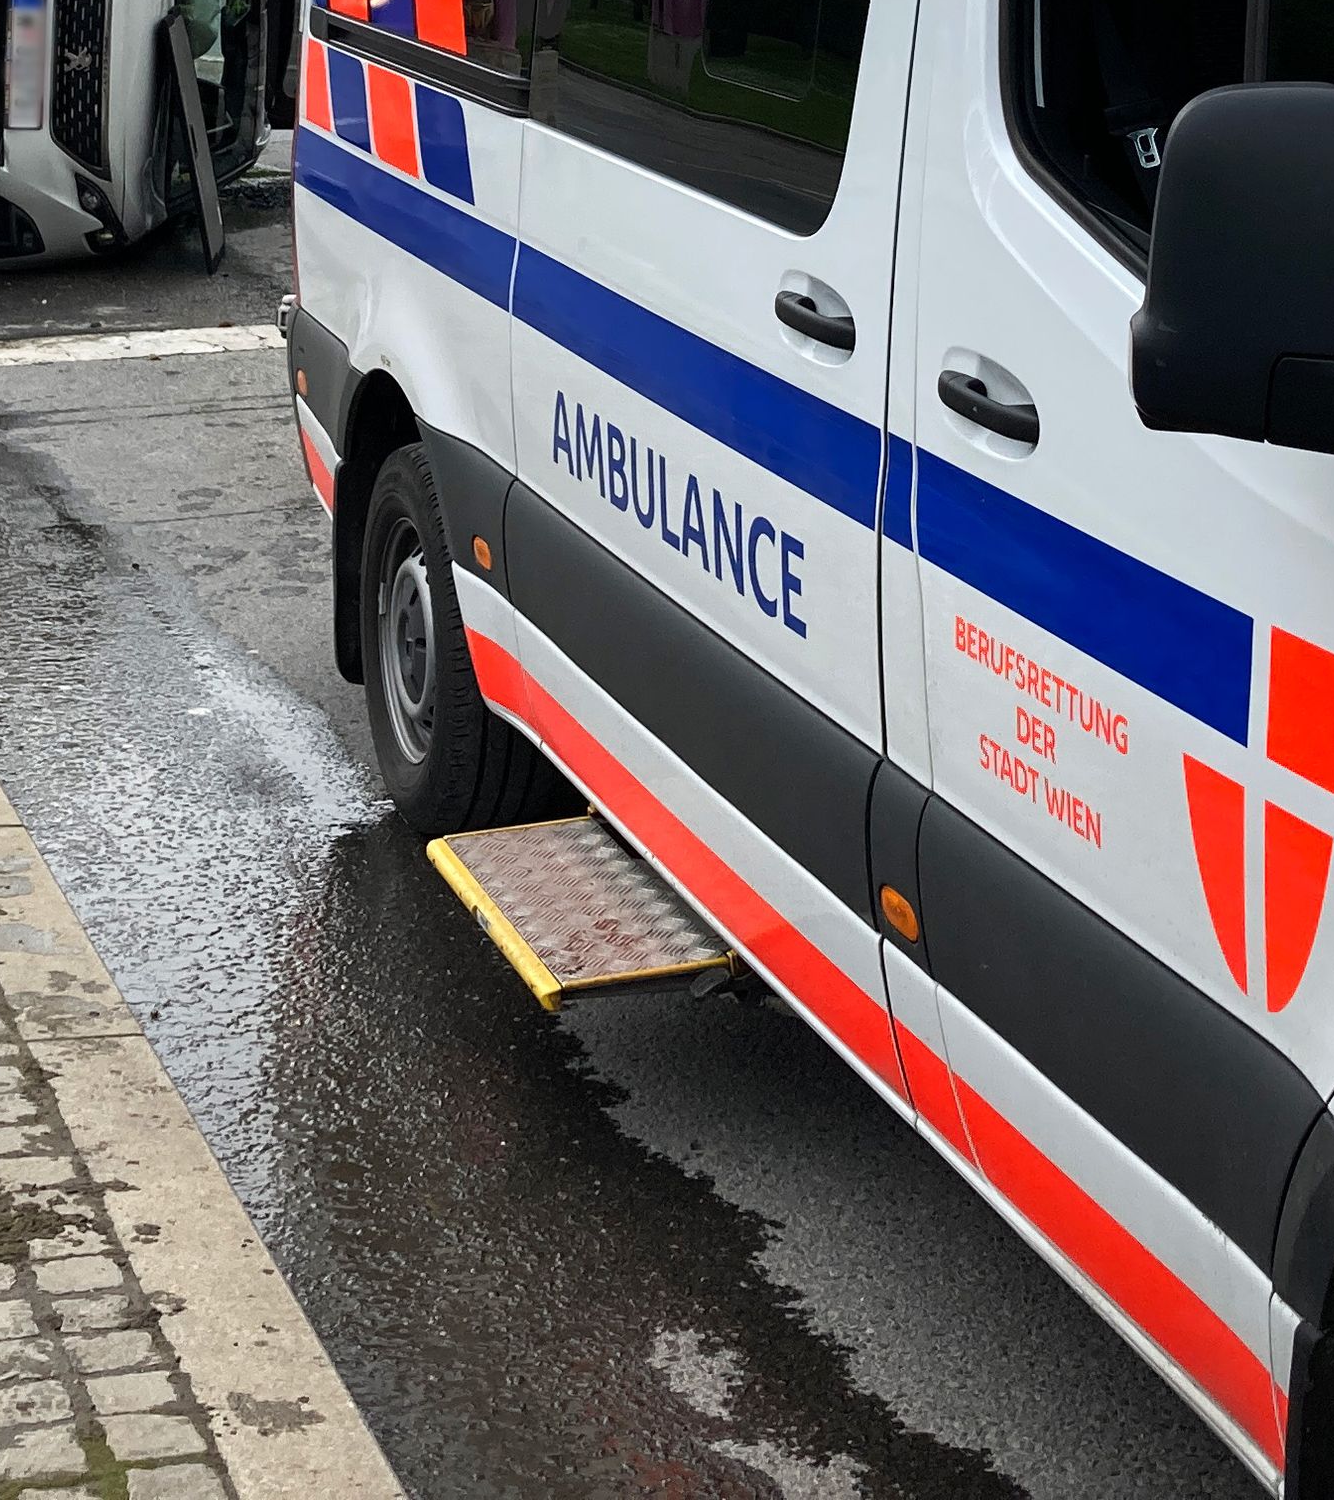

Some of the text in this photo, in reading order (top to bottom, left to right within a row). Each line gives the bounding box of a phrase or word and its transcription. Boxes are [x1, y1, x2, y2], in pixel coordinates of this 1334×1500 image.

[553, 390, 807, 639] AMBULANCE
[955, 616, 1128, 755] BERUFSRETTUNG
[1016, 706, 1056, 764] DER
[979, 734, 1101, 850] STADT WIEN
